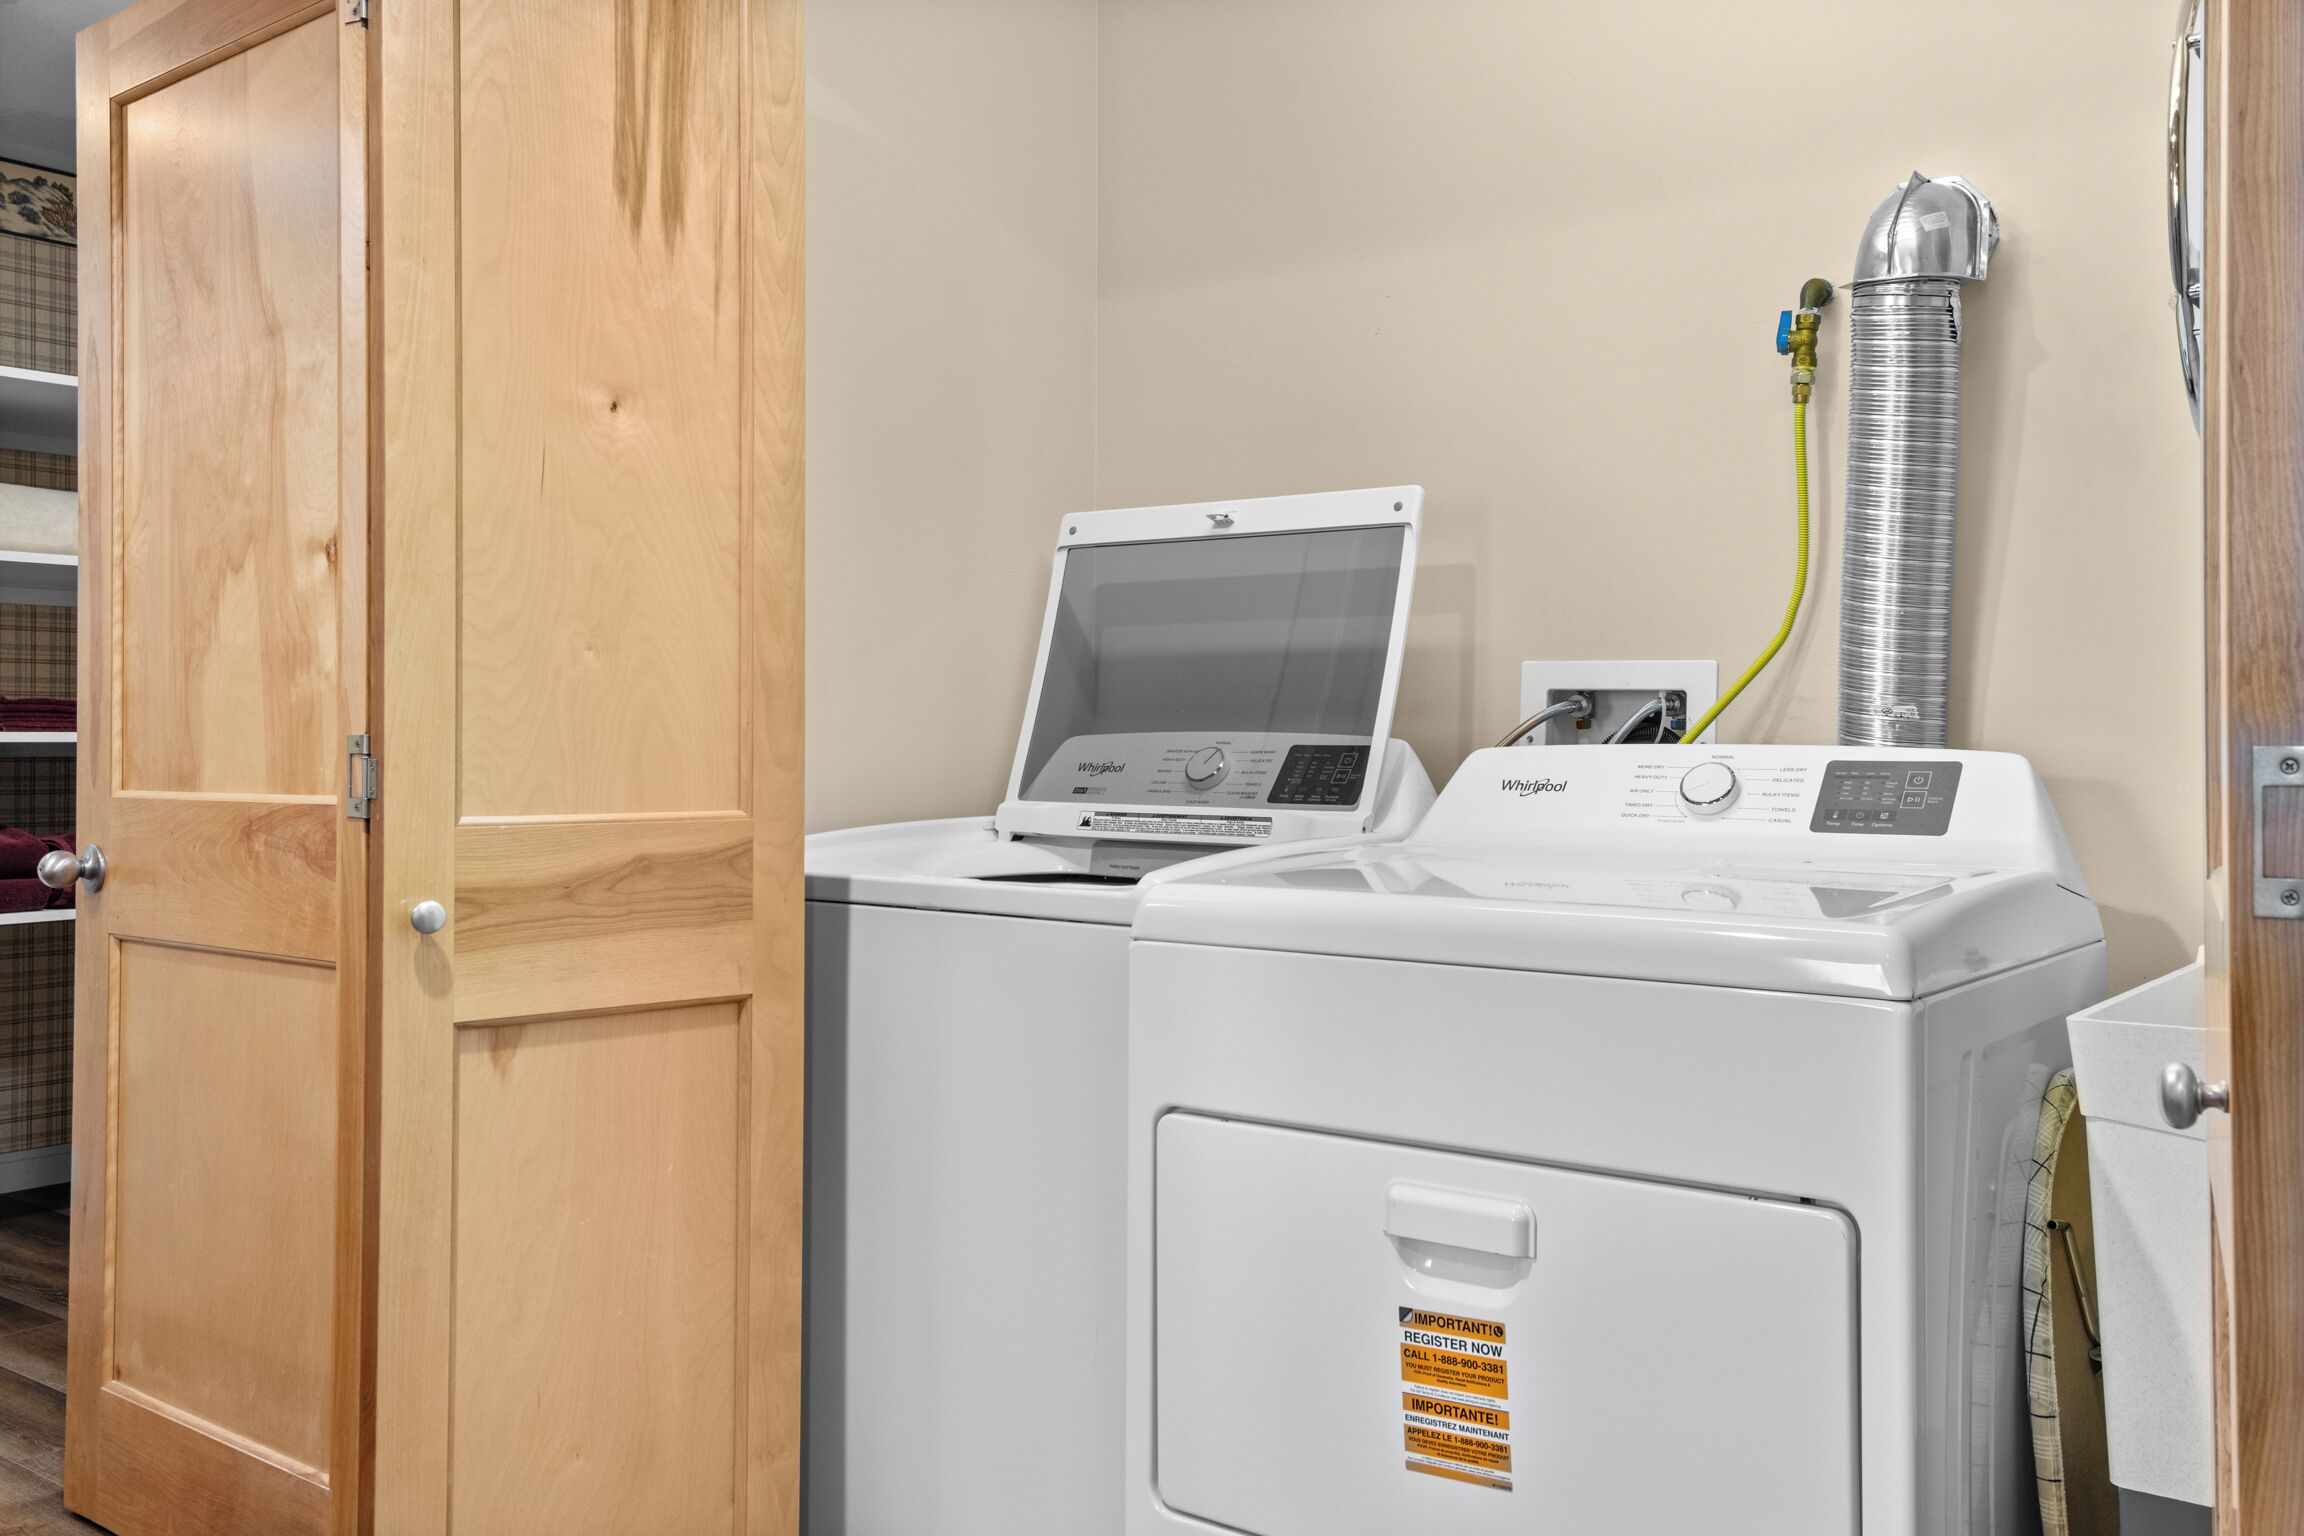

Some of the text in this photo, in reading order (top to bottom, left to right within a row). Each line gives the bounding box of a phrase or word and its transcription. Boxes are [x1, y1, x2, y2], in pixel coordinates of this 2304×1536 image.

[1078, 761, 1125, 777] Whirlpool
[1502, 778, 1568, 796] Whirlpool
[1414, 1312, 1492, 1336] IMPORTANT!
[1404, 1330, 1502, 1357] REGISTER NOW
[1404, 1348, 1504, 1374] CALL 1-888-900-3381
[1418, 1363, 1432, 1372] MUST
[1434, 1366, 1461, 1376] REGISTER
[1478, 1374, 1504, 1384] PRODUCT
[1412, 1398, 1498, 1425] IMPORTANTE!
[1405, 1414, 1509, 1441] ENREGISTREZ MAINTENANT
[1407, 1427, 1508, 1453] APPELEZ LE 1-888-900-3381
